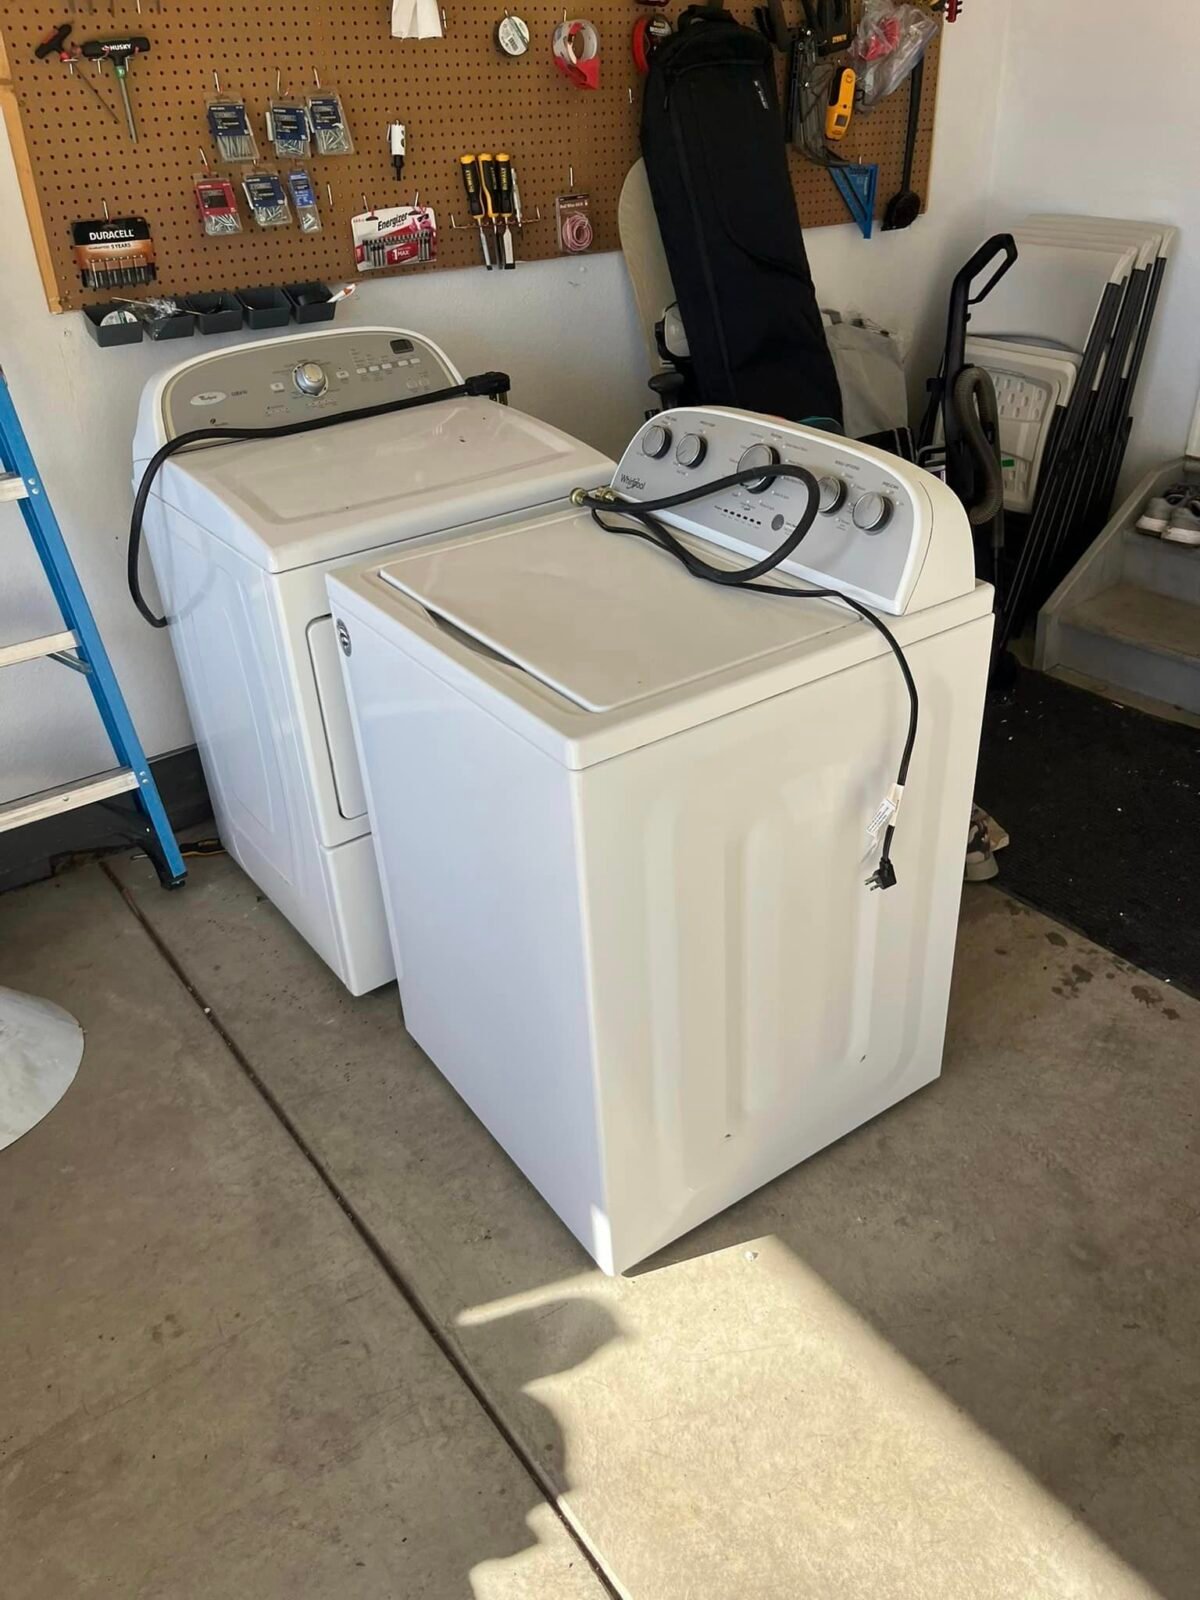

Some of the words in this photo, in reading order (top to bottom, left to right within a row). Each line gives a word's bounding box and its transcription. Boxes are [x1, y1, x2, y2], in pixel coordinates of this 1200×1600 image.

[377, 212, 408, 232] Energizer
[88, 229, 135, 241] DURACELL
[620, 473, 646, 490] Whirlpool
